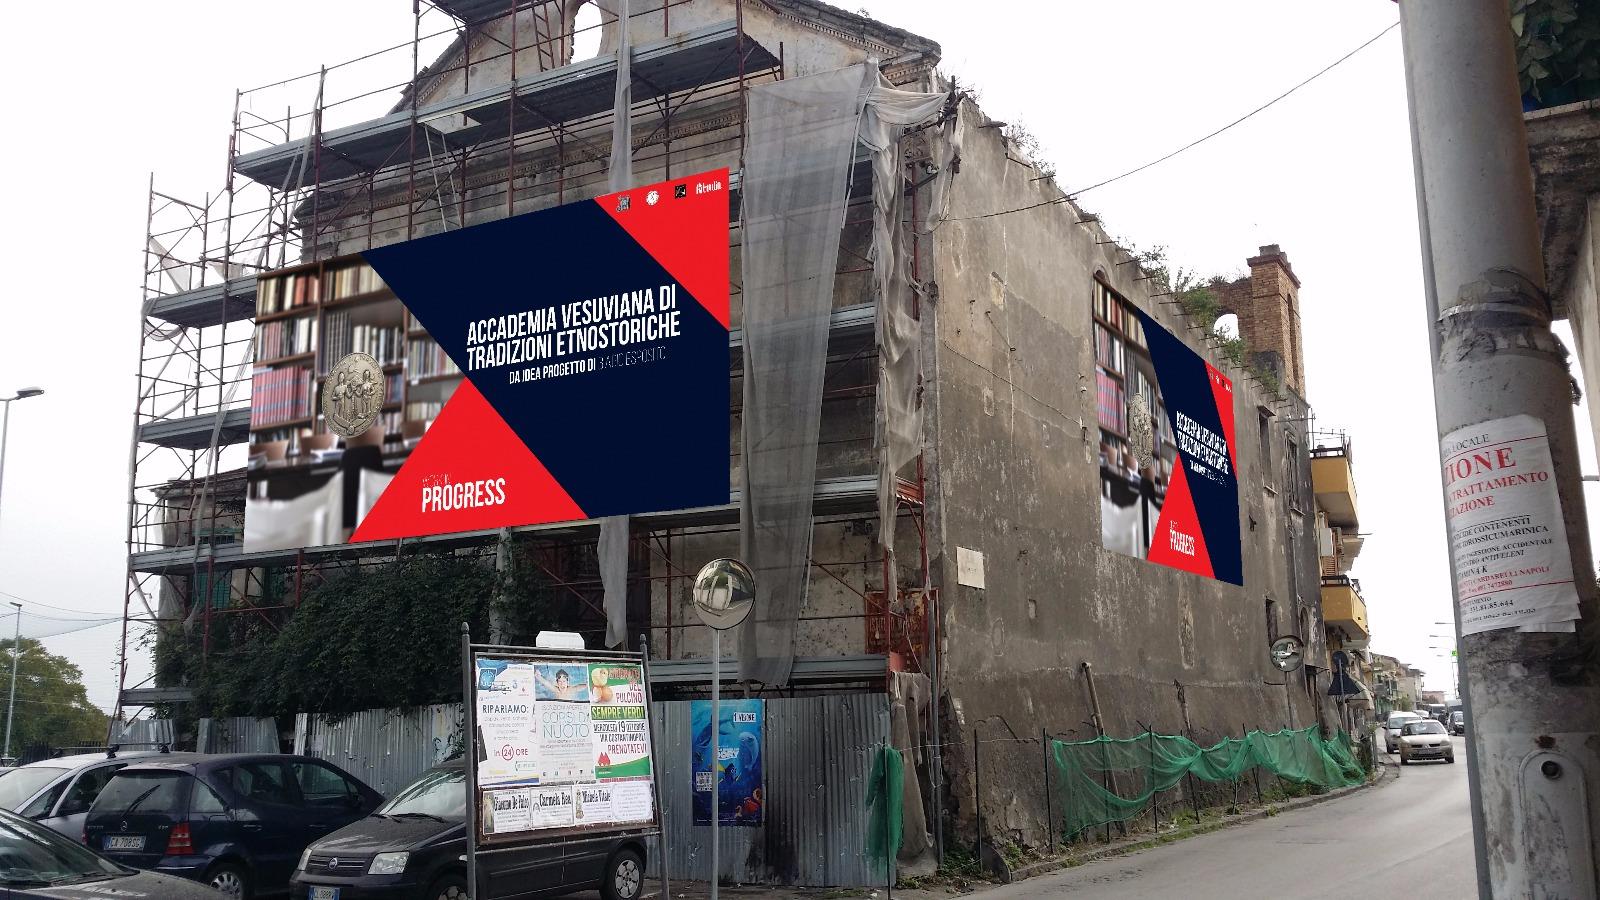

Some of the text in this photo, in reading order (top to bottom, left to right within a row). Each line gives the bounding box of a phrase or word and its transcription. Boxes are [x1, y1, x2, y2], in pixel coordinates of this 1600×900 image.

[467, 283, 677, 346] ACCADEMIA VESUVIANA DI
[467, 310, 681, 371] TRADIZIONI ETNOSTORICHE
[509, 370, 521, 385] DA
[522, 366, 541, 382] IDEA
[543, 360, 586, 378] PROGETTO
[587, 357, 596, 372] DI
[1452, 433, 1490, 453] LOCALE
[421, 477, 506, 513] PROGRESS
[1474, 517, 1531, 534] CONTENENTI
[482, 704, 529, 714] RIPARIAMO:
[592, 706, 644, 720] SEMPRE VERDI
[543, 724, 590, 739] NUOTO
[618, 720, 626, 733] 19
[503, 748, 512, 757] 24
[515, 748, 529, 756] ORE
[608, 743, 647, 755] PRENOTATEVI
